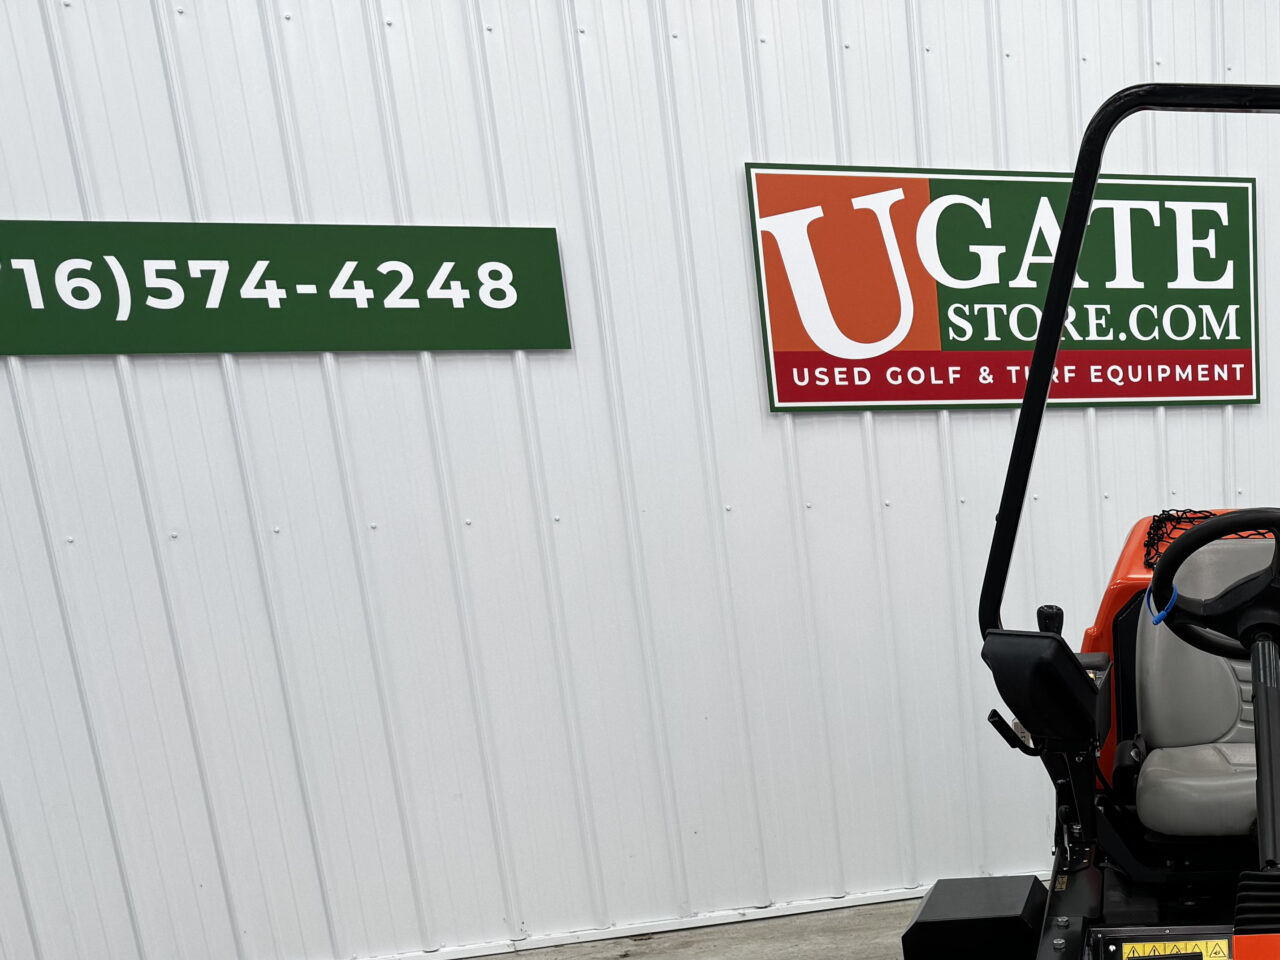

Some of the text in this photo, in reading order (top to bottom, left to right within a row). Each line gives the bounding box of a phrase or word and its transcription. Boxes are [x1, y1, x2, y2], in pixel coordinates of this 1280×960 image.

[0, 256, 517, 321] 16)574-4248
[948, 303, 1241, 341] STORE.COM
[793, 368, 870, 386] USED
[886, 367, 960, 384] GOLF
[979, 366, 993, 383] &
[1091, 364, 1244, 385] EQUIPMENT
